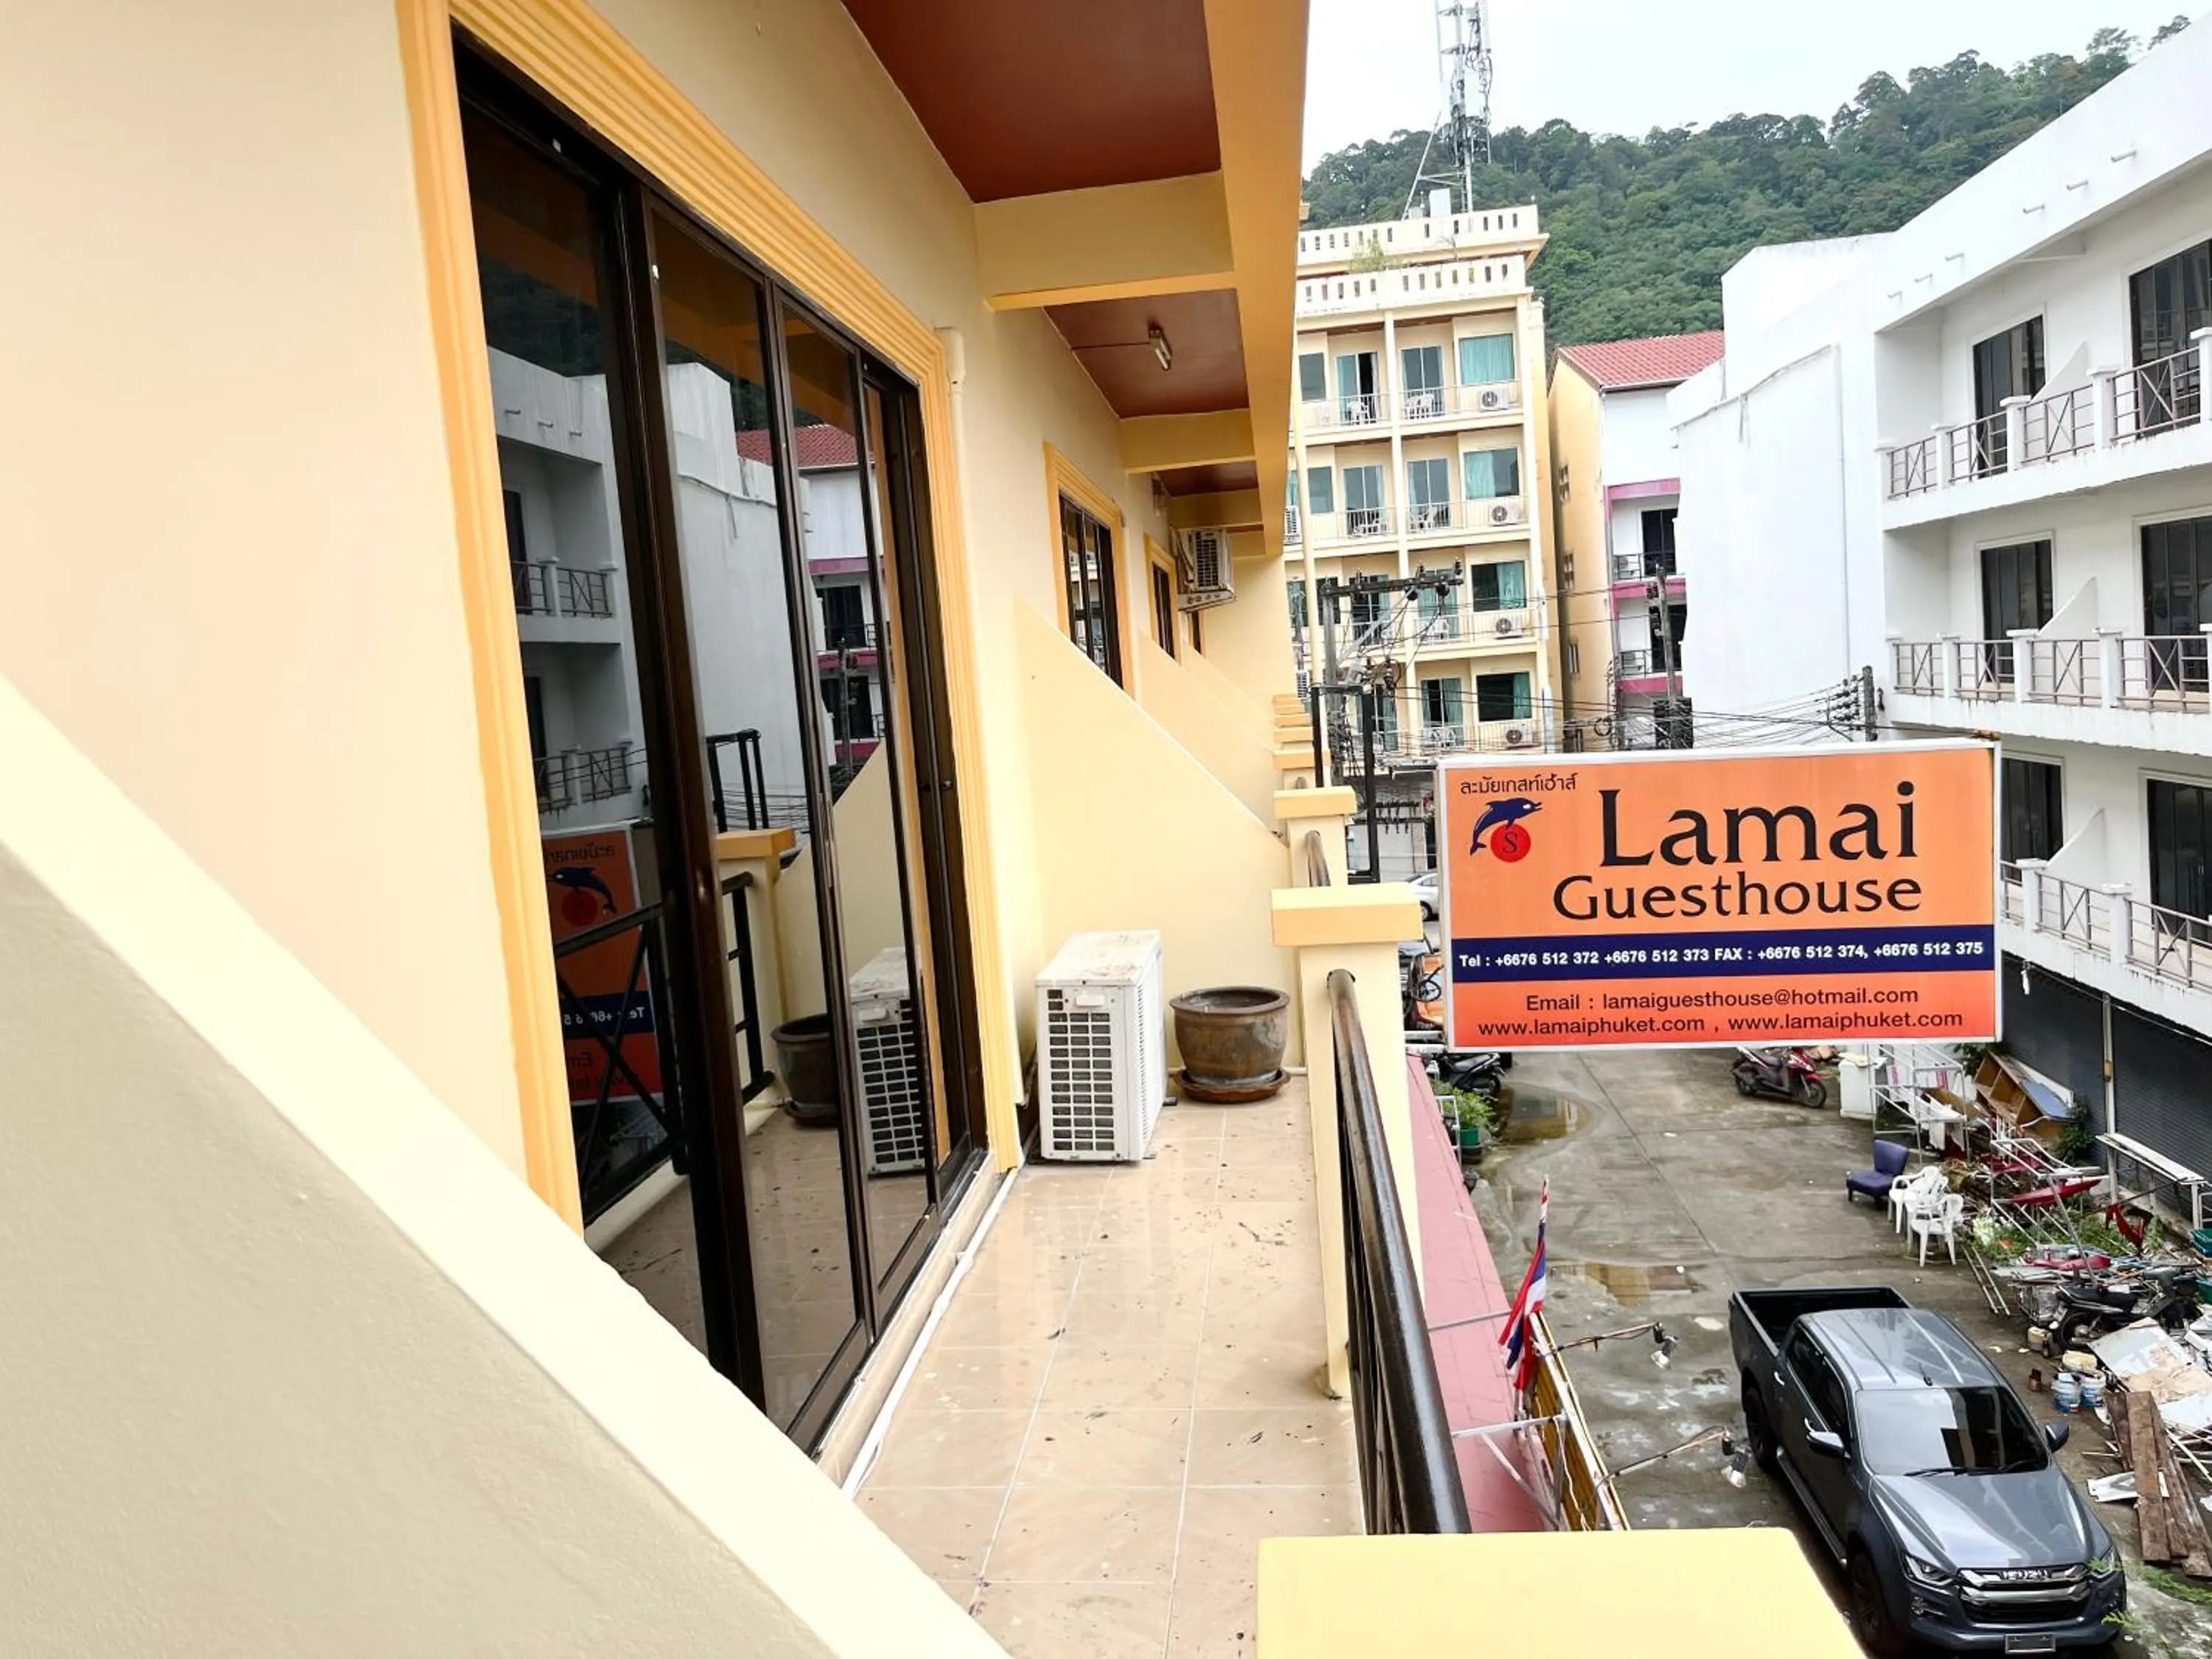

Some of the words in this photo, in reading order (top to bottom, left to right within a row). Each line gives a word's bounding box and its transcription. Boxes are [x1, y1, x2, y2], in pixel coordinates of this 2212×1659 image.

[1599, 781, 1917, 867] Lamai
[1553, 871, 1921, 920] Guesthouse
[1459, 953, 1481, 967] Tel
[1494, 953, 1537, 966] +6676
[1542, 952, 1568, 965] 512
[1573, 951, 1599, 964] 372
[1604, 950, 1647, 964] +6676
[1652, 949, 1678, 962] 512
[1683, 948, 1709, 961] 373
[1714, 947, 1742, 961] FAX
[1757, 946, 1801, 959] +6676
[1806, 945, 1833, 959] 512
[1837, 945, 1868, 959] 374,
[1874, 943, 1919, 956] +6676
[1923, 942, 1951, 956] 512
[1955, 942, 1983, 955] 375
[1526, 994, 1580, 1011] Email
[1603, 987, 1919, 1012] lamaiguesthouse@hotmail.com
[1478, 1017, 1705, 1037] www.lamaiphuket.com
[1728, 1012, 1963, 1032] www.lamaiphuket.com
